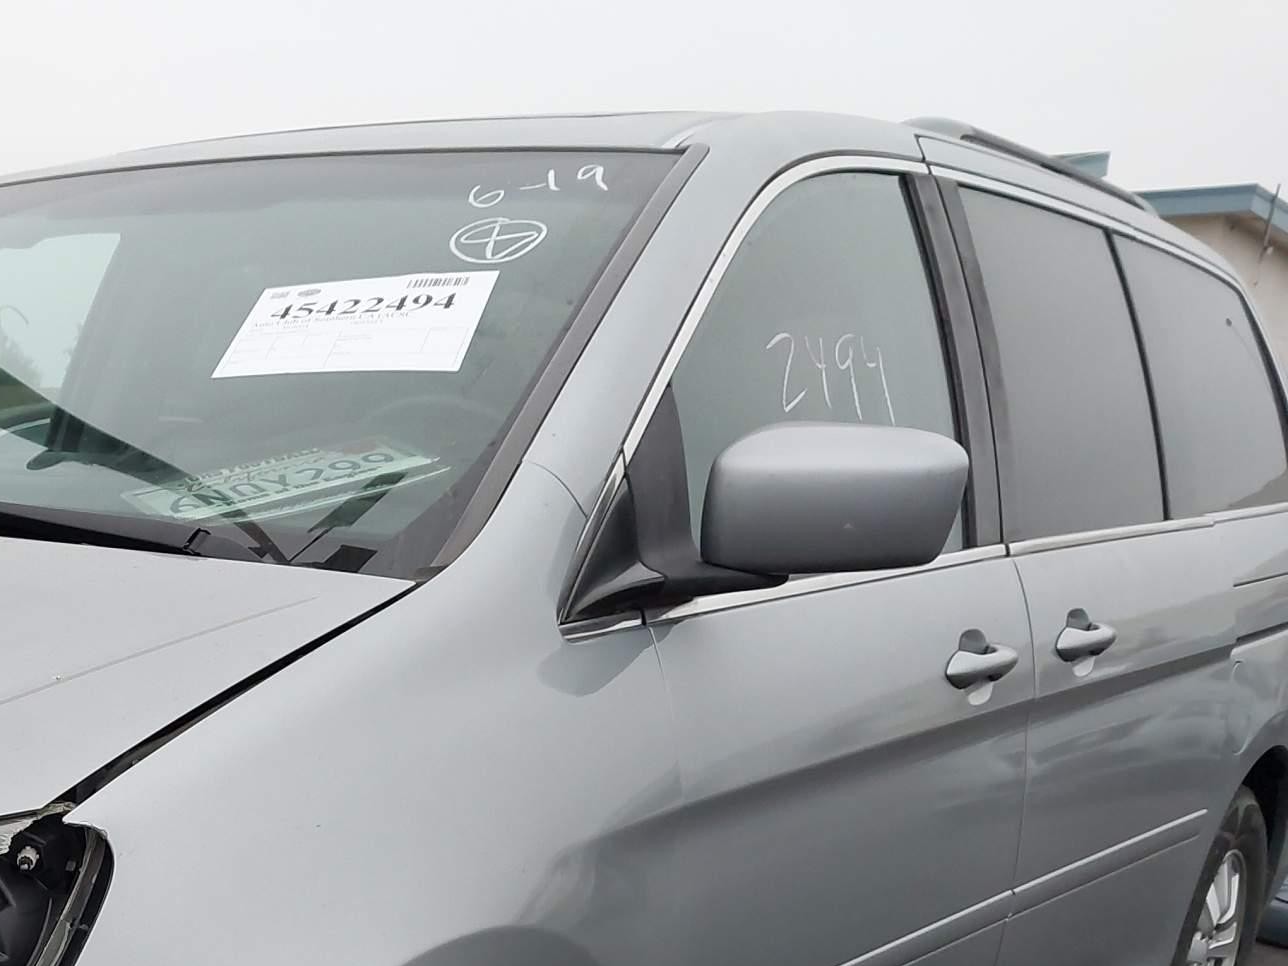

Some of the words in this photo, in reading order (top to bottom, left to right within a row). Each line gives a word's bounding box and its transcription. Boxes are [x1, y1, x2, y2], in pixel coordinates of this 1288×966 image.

[468, 164, 609, 208] 6-19
[270, 291, 456, 320] 45422494
[765, 331, 897, 426] 2494
